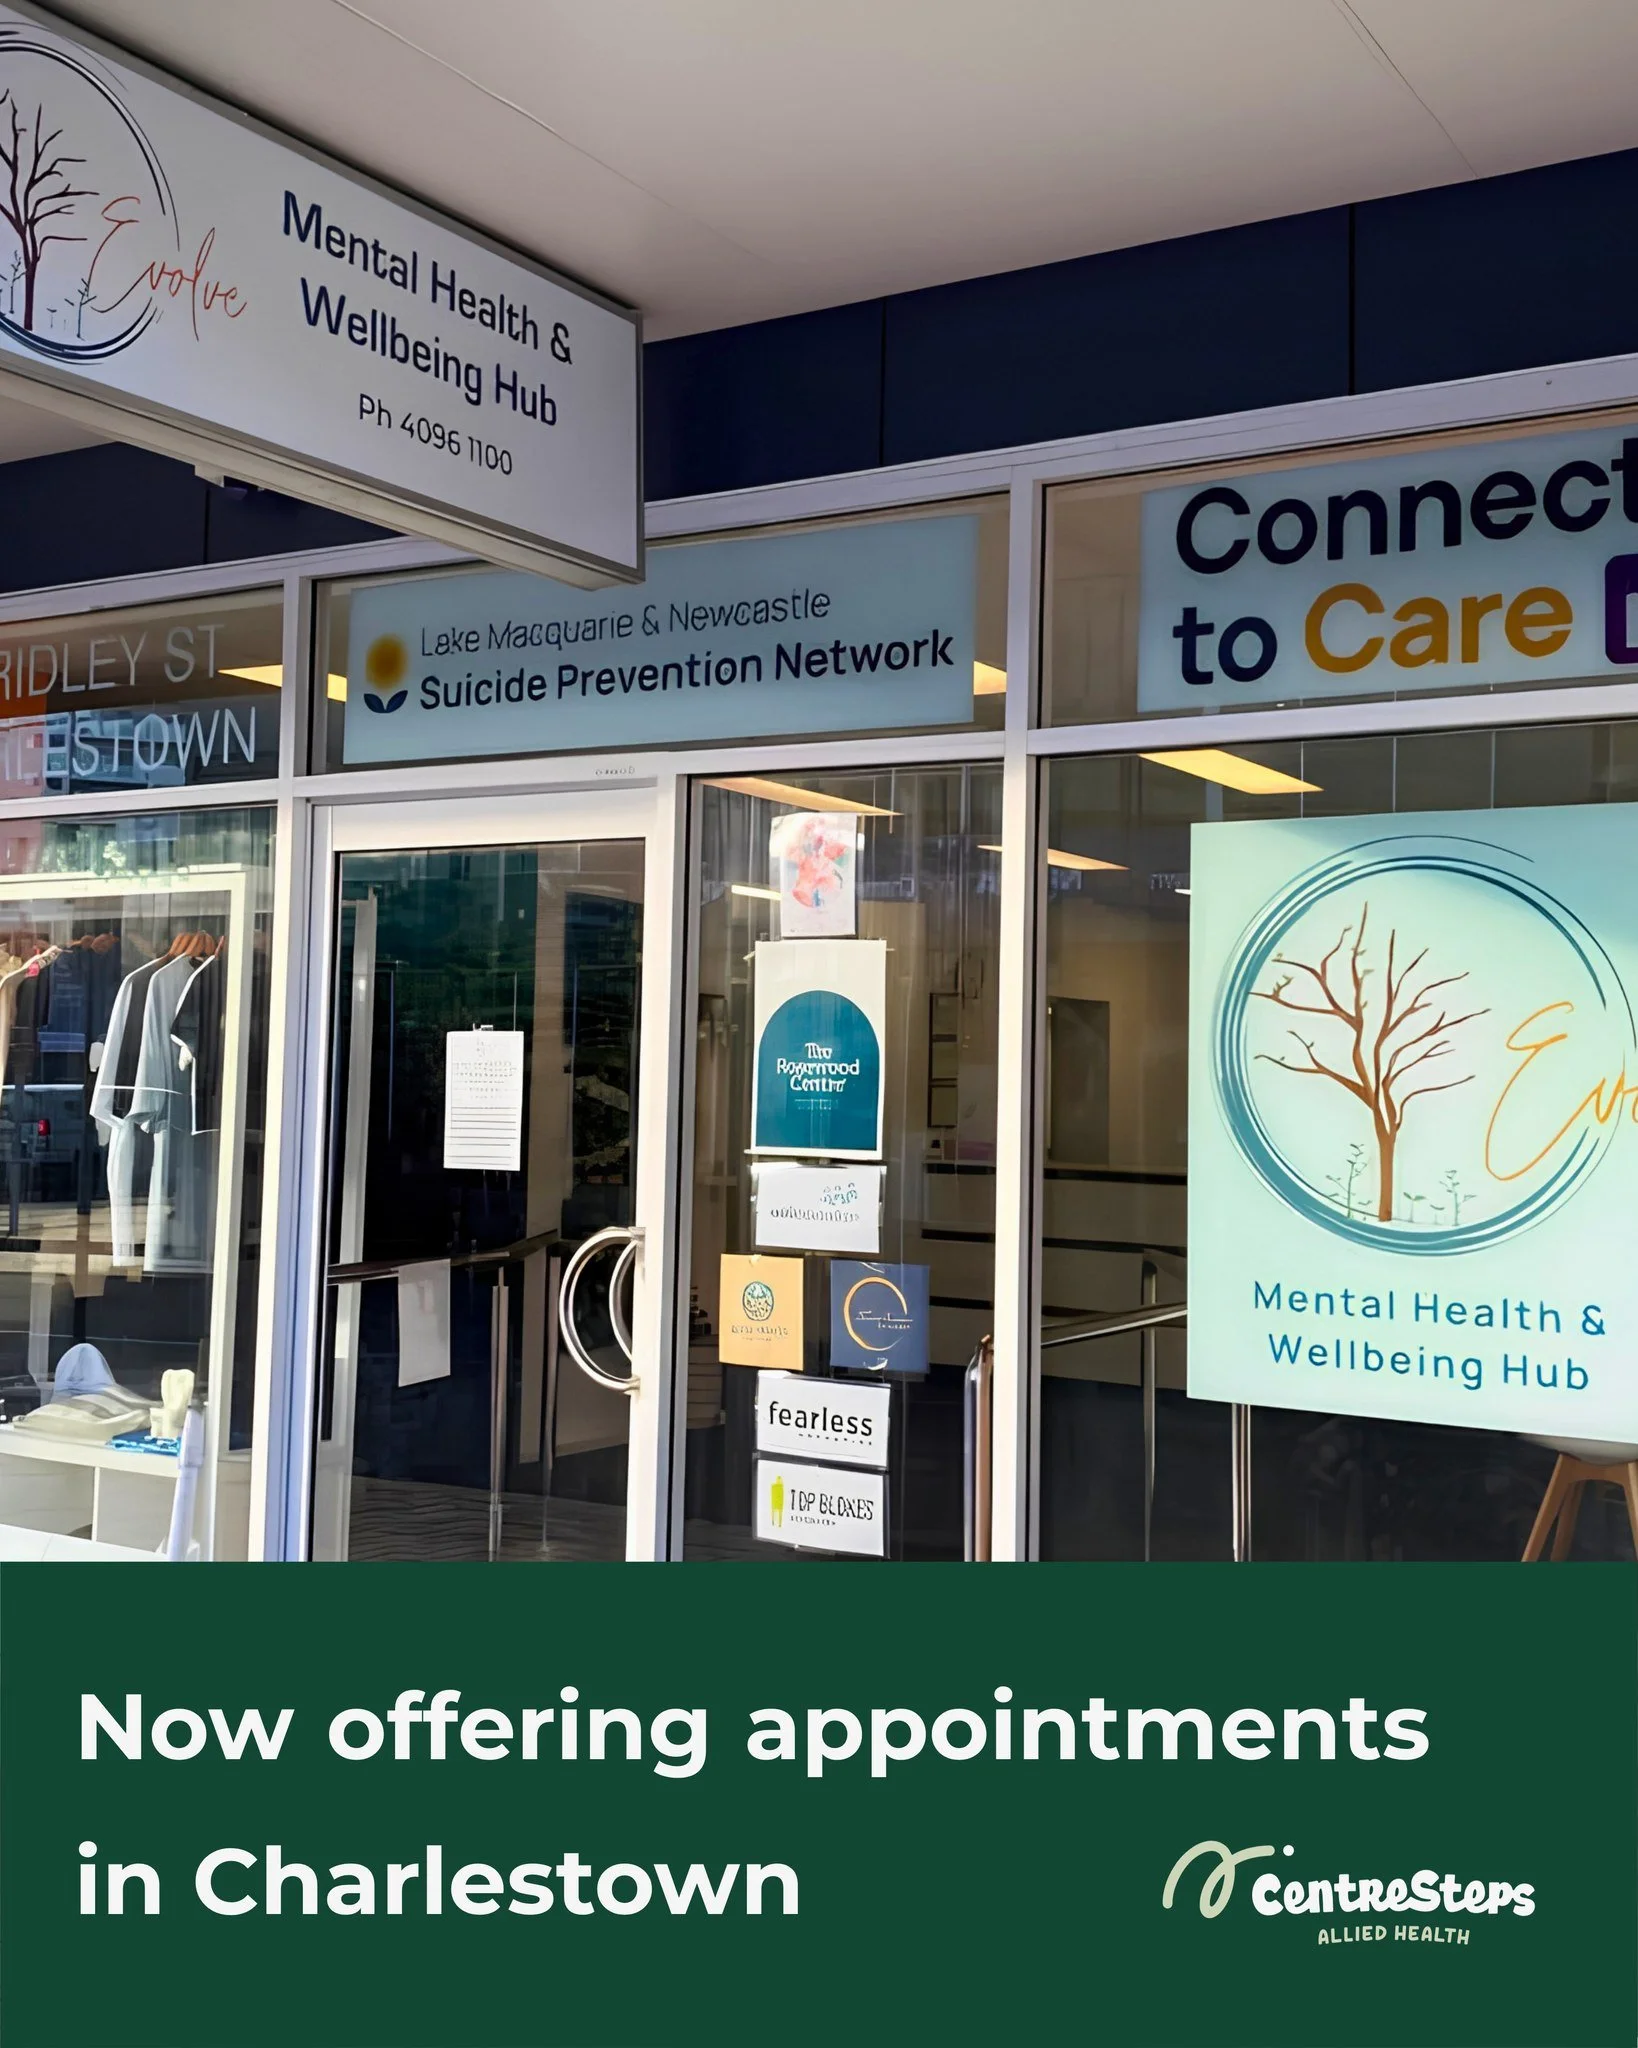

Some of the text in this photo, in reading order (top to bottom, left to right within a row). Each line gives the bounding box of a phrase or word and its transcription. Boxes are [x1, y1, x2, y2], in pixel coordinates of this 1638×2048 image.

[87, 195, 248, 342] Evolve
[283, 189, 573, 366] Mental Health &
[300, 277, 557, 427] Wellbeing Hub
[359, 393, 513, 476] Ph 4096 1100
[1176, 437, 1638, 574] Connect
[163, 624, 225, 683] ST
[421, 587, 831, 657] Lake Macquarie & Newcastle
[1172, 582, 1573, 685] to Care
[420, 629, 956, 710] Suicide Prevention Network
[1254, 1280, 1606, 1336] Mental Health &
[1268, 1333, 1589, 1391] Wellbeing Hub
[769, 1400, 873, 1437] fearless
